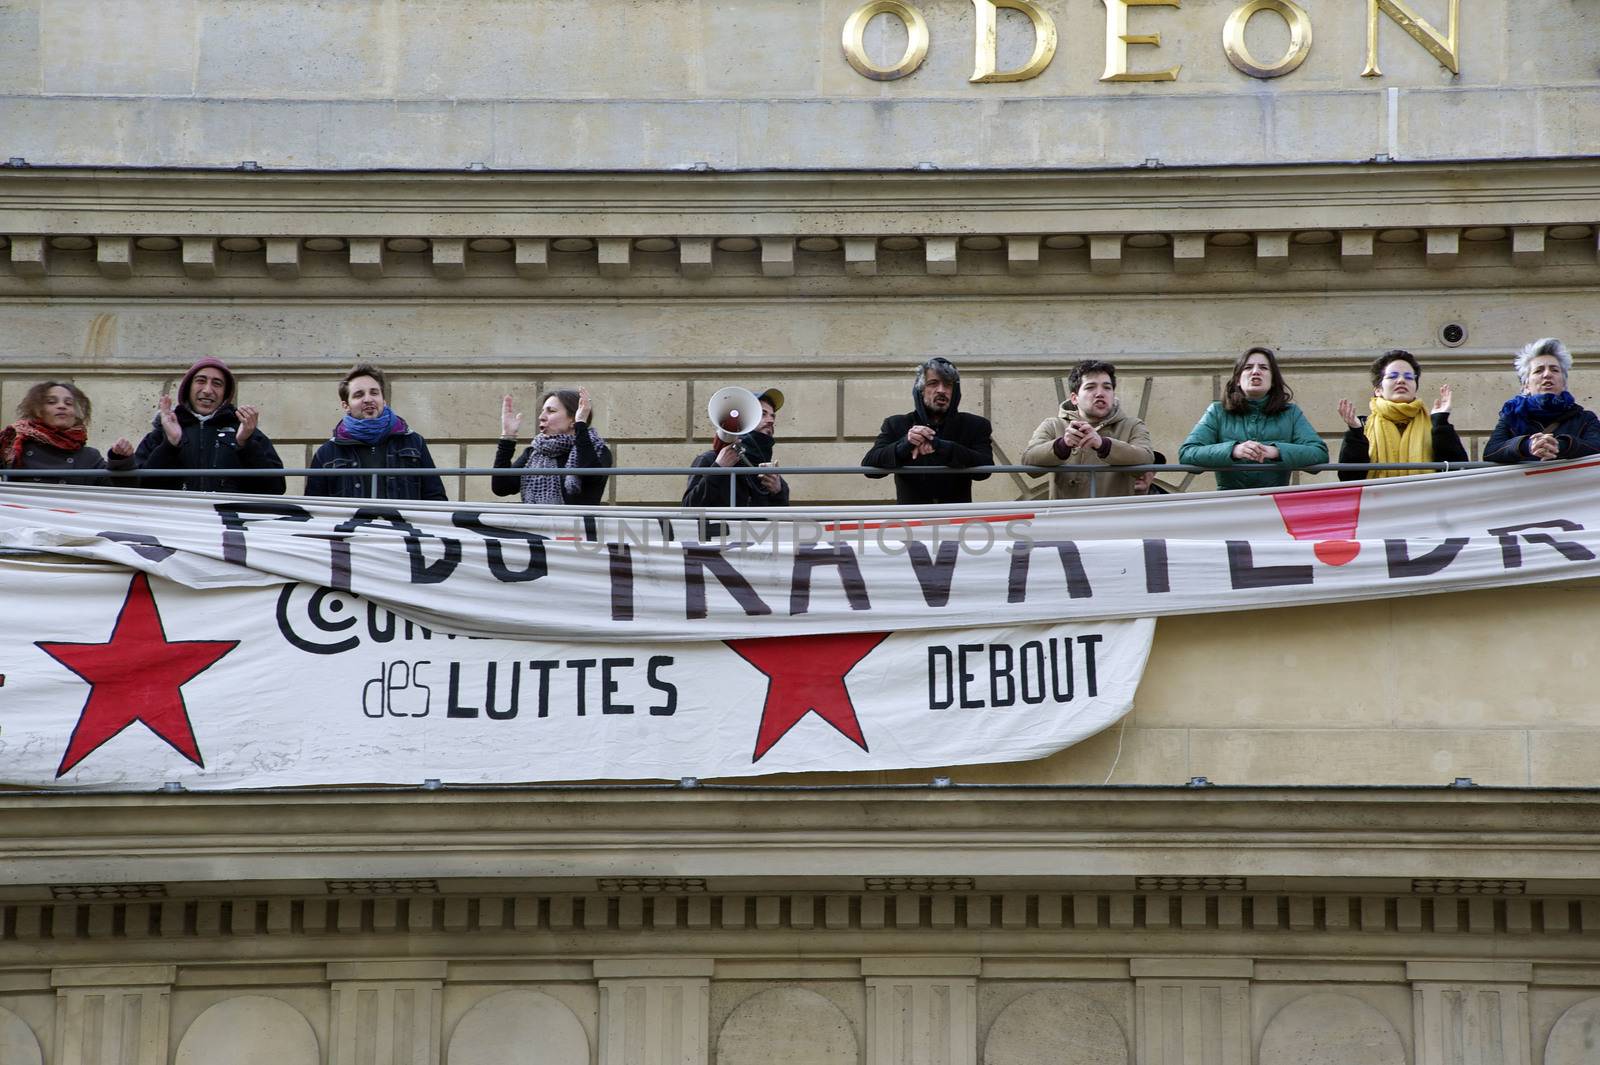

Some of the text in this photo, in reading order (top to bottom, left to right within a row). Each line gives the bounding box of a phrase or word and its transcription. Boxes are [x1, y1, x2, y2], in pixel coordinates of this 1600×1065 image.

[841, 0, 1460, 84] ODEON
[363, 656, 677, 719] des LUTTES
[928, 634, 1103, 710] DEBOUT
